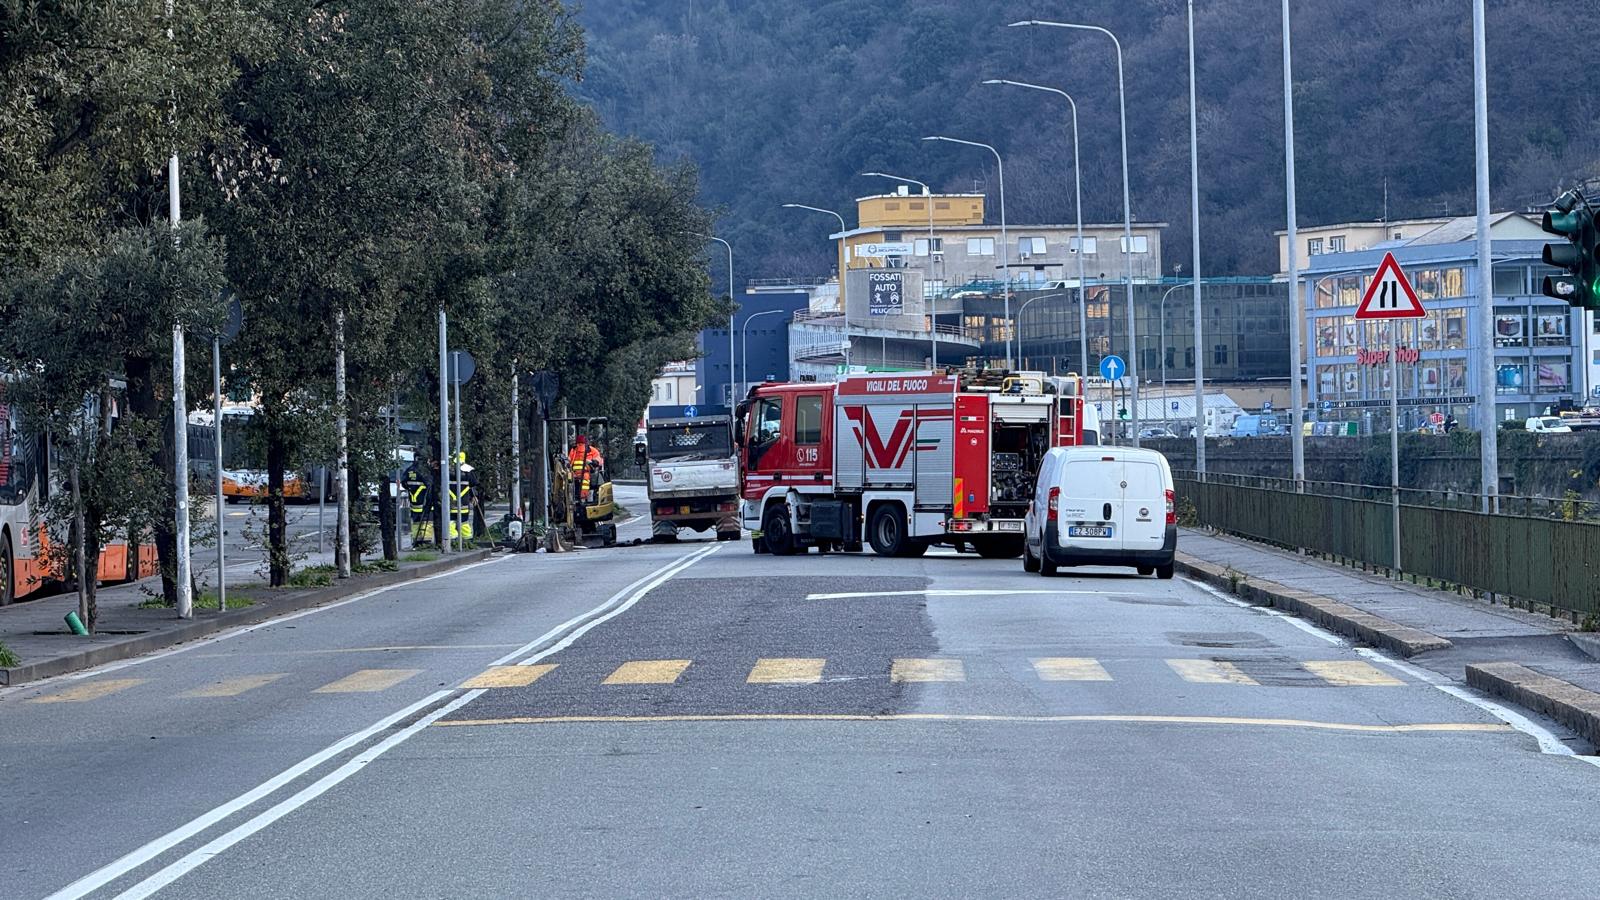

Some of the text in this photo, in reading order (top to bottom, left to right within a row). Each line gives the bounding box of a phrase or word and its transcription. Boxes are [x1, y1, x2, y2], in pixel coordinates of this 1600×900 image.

[869, 273, 901, 281] FOSSATI
[874, 283, 897, 292] AUTO
[1357, 346, 1419, 368] Super hop
[866, 379, 928, 392] VIGILI DEL FUOCO
[805, 448, 818, 462] 115
